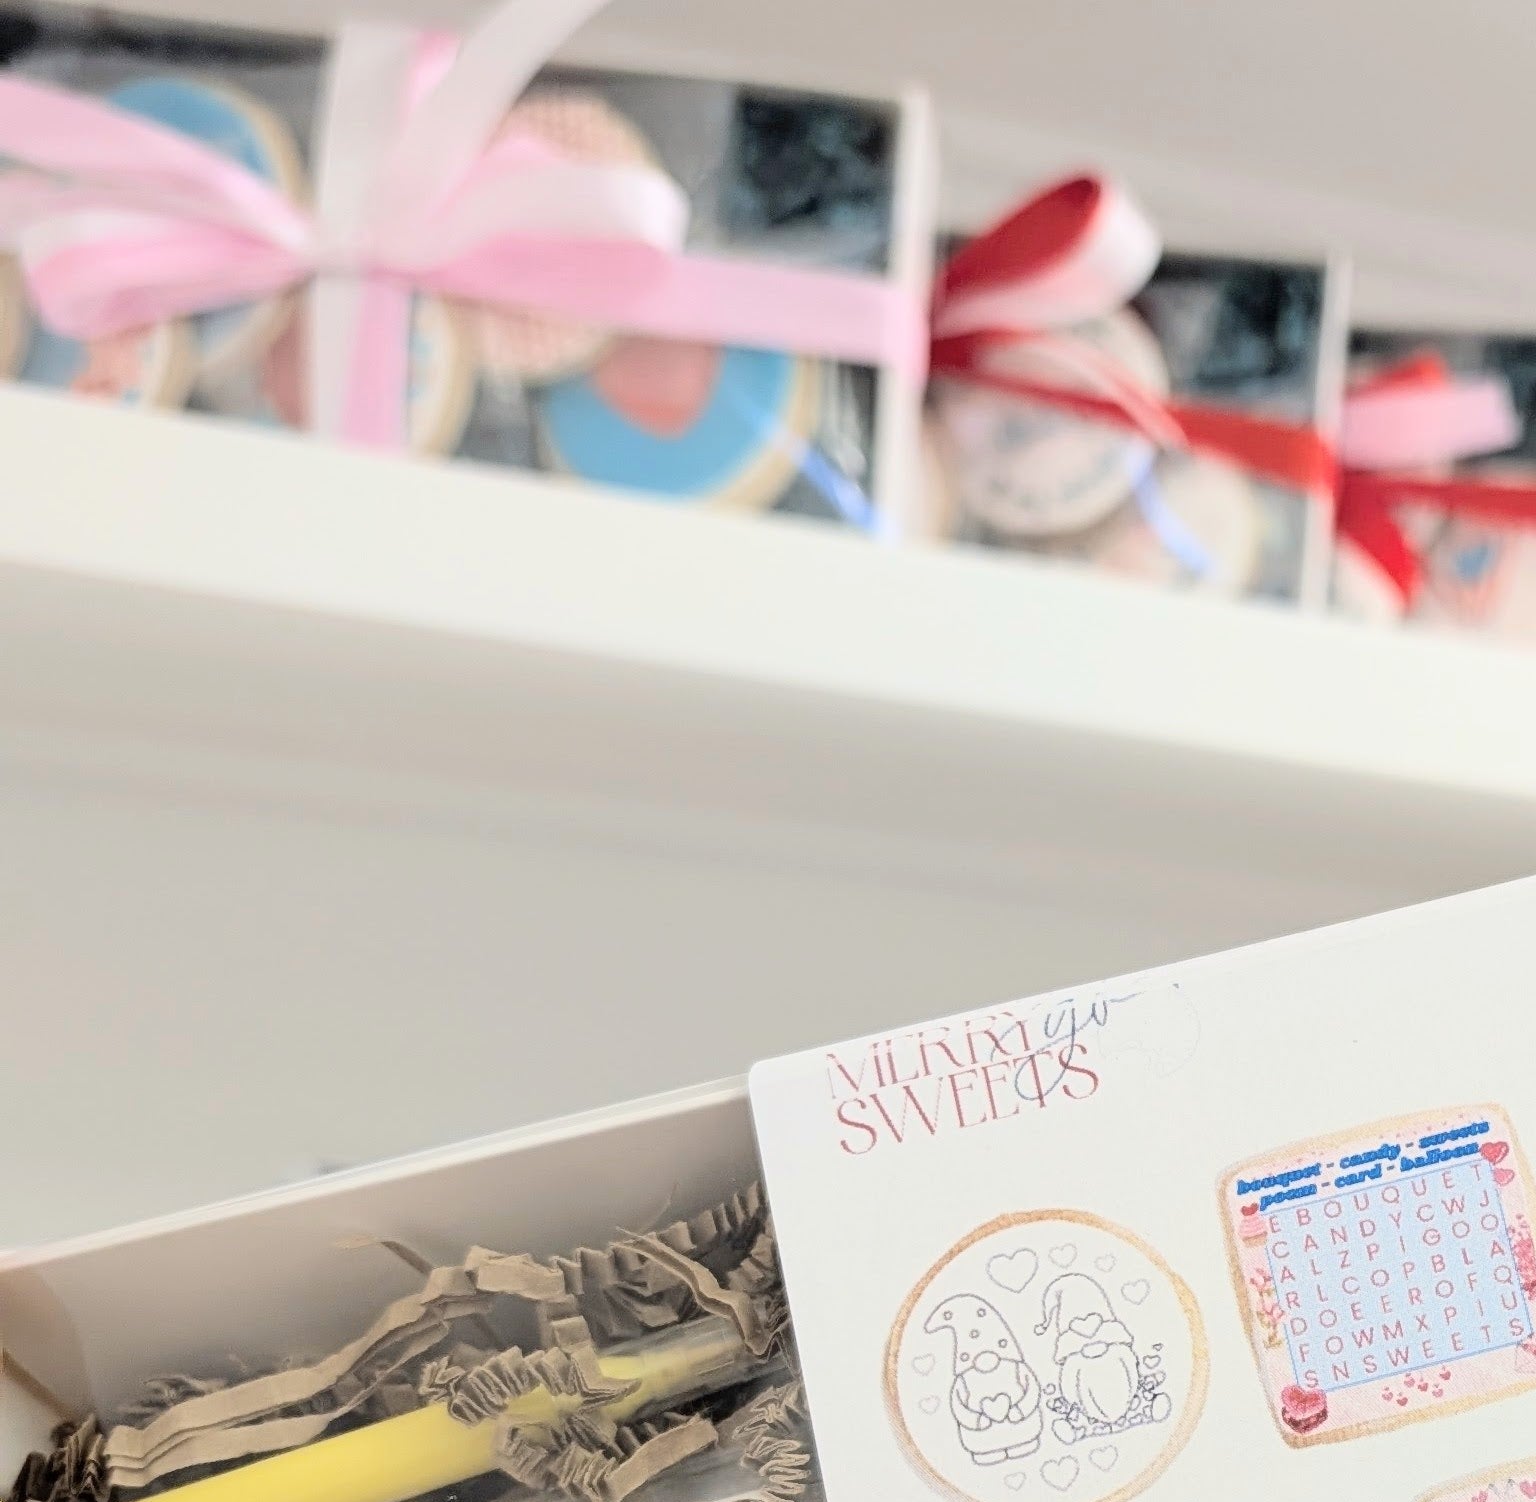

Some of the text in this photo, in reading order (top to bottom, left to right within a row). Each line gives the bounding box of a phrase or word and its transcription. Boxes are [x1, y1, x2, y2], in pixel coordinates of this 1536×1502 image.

[836, 1044, 1099, 1155] SWEETS
[1339, 1143, 1400, 1168] candy
[1334, 1163, 1382, 1188] card
